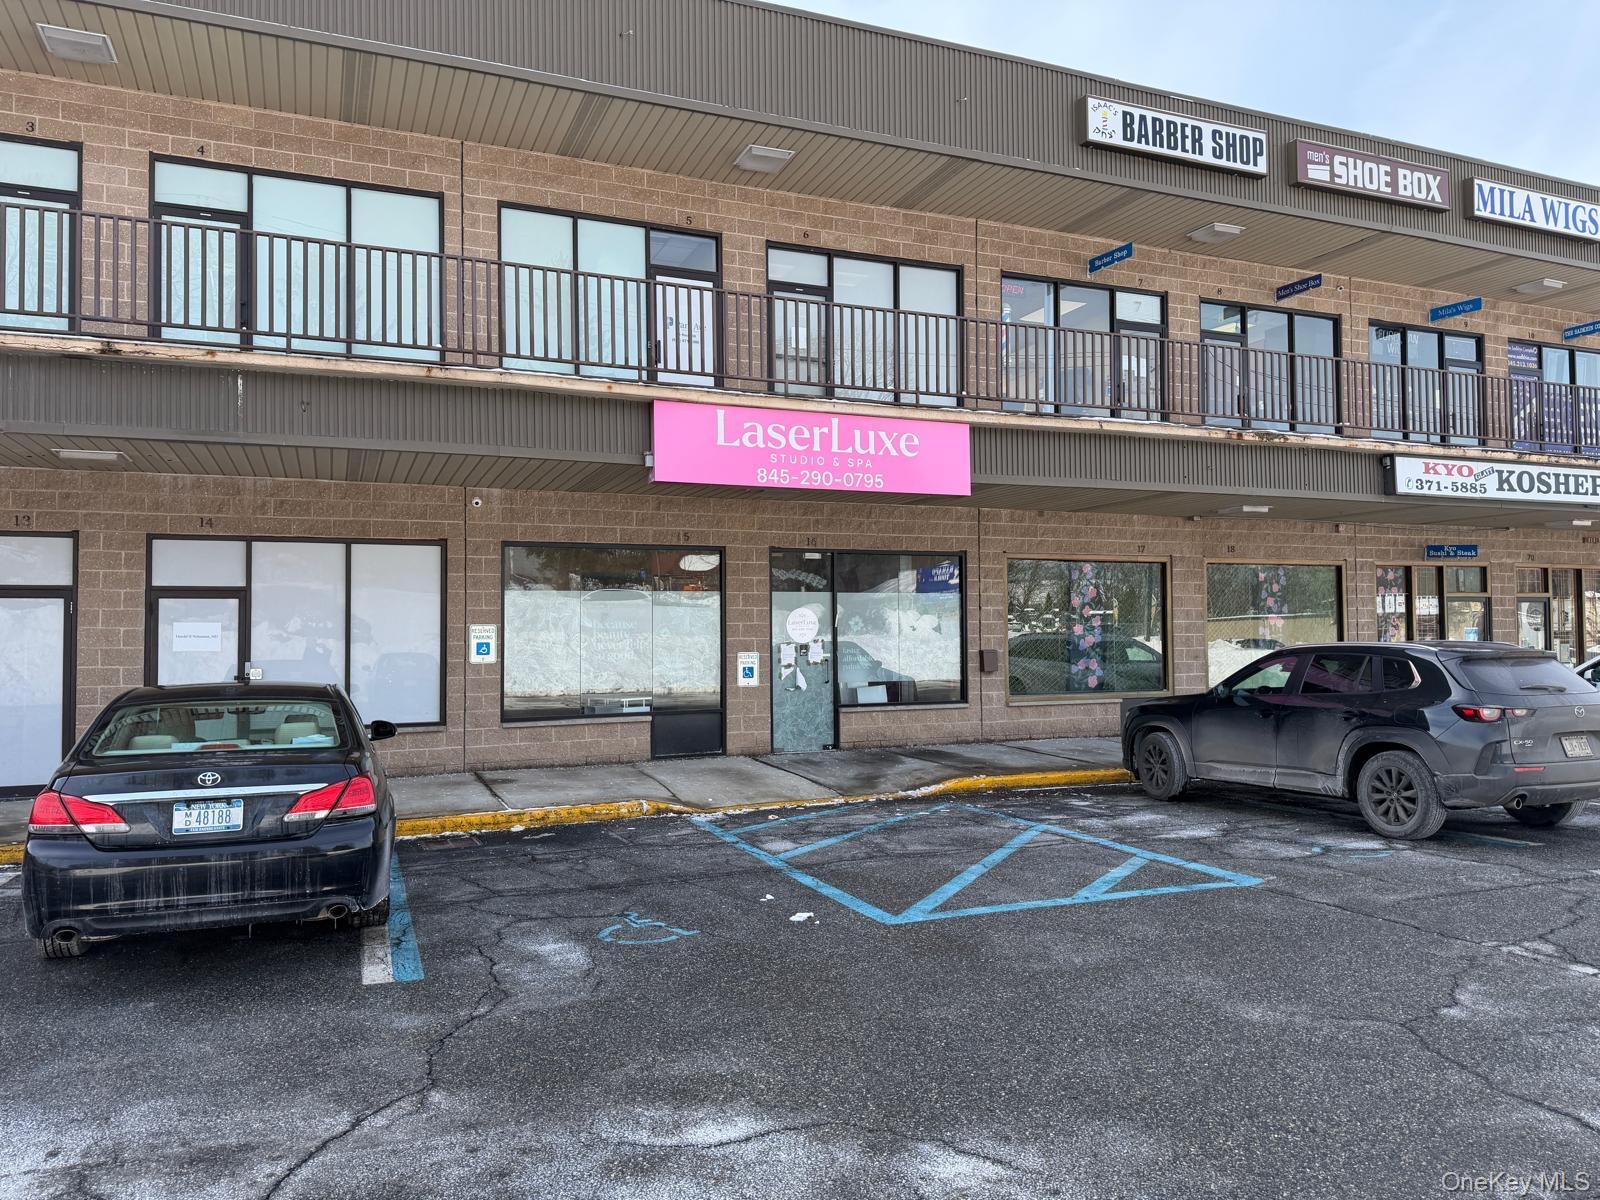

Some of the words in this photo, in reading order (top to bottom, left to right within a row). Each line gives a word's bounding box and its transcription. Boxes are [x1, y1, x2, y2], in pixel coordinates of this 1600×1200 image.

[1091, 102, 1118, 117] ISAAC'S
[25, 121, 35, 132] 3
[1122, 110, 1204, 156] BARBER
[1211, 128, 1264, 167] SHOP
[196, 145, 205, 155] 4
[1307, 150, 1330, 164] men's
[1333, 154, 1392, 193] SHOE
[1397, 167, 1443, 202] BOX
[1475, 183, 1537, 223] MILA
[1540, 197, 1600, 236] WIGS
[686, 216, 692, 225] 5
[803, 231, 809, 239] 6
[1094, 255, 1112, 267] Barber
[1113, 249, 1128, 259] Shop
[1138, 278, 1144, 287] 7
[1217, 287, 1222, 295] 8
[716, 408, 920, 458] LaserLuxe
[770, 453, 825, 466] STUDIO
[832, 456, 840, 467] &
[847, 457, 873, 468] SPA
[1422, 461, 1474, 478] KYO
[756, 468, 884, 489] 845-290-0795
[1415, 478, 1487, 494] 371-5885
[13, 515, 31, 527] 13
[199, 517, 214, 528] 14
[1137, 545, 1146, 553] 17
[1227, 545, 1235, 553] 18
[196, 809, 231, 826] 48188
